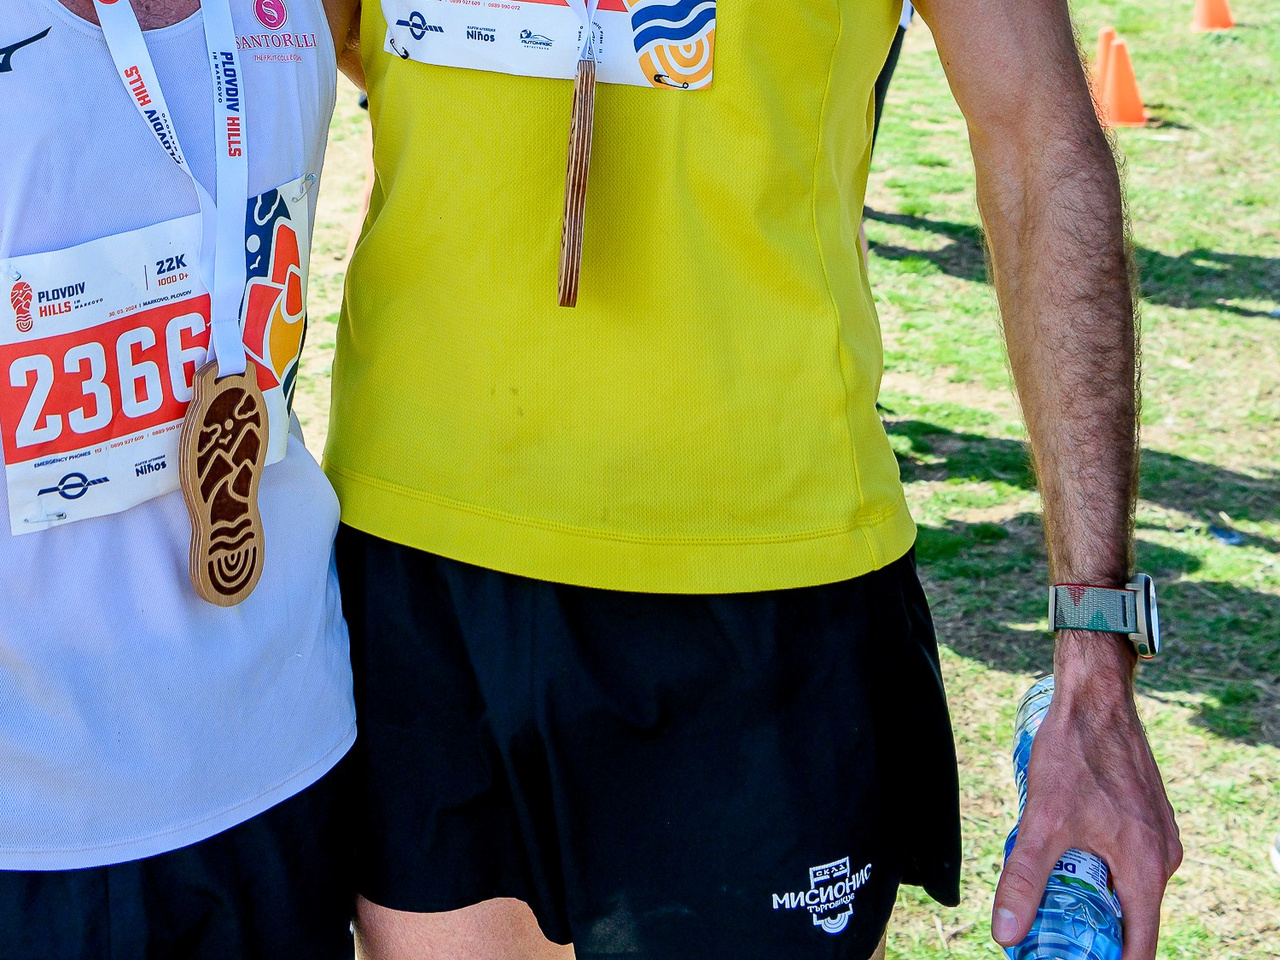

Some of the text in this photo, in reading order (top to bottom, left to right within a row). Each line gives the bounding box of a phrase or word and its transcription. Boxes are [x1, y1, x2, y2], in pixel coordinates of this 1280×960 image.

[124, 65, 152, 107] HILLS
[220, 52, 241, 157] PLOVDIV HILLS
[155, 253, 188, 275] 22K
[157, 274, 177, 287] 1000
[38, 282, 86, 303] PLOVDIV
[38, 301, 71, 318] HILLS
[9, 313, 210, 448] 2366
[34, 456, 68, 469] EMERGENCY
[68, 450, 91, 461] PHONES
[772, 863, 872, 909] МИСИОНИС
